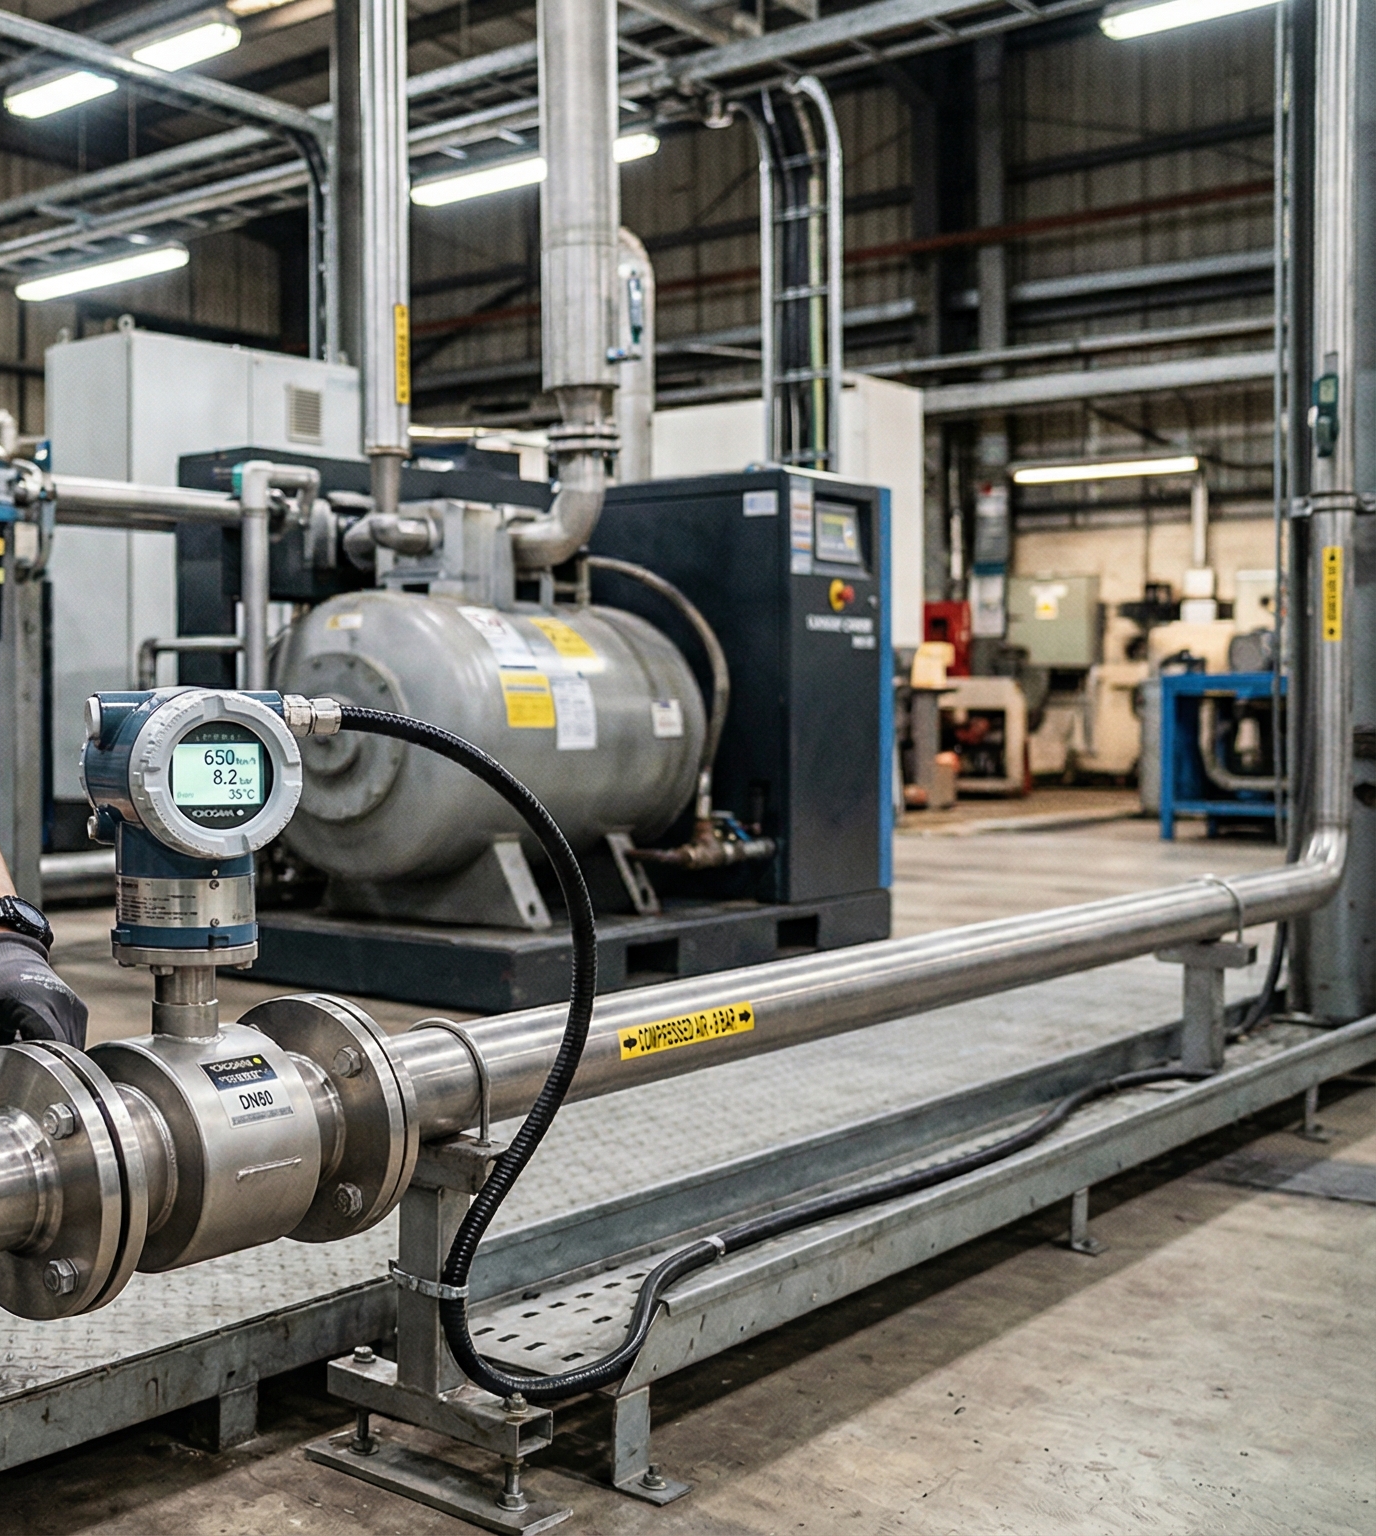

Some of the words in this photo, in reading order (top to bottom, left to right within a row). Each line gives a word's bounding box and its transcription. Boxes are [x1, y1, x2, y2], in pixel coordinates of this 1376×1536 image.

[204, 749, 235, 766] 650
[213, 769, 237, 785] 8.2
[228, 788, 255, 800] 35°C
